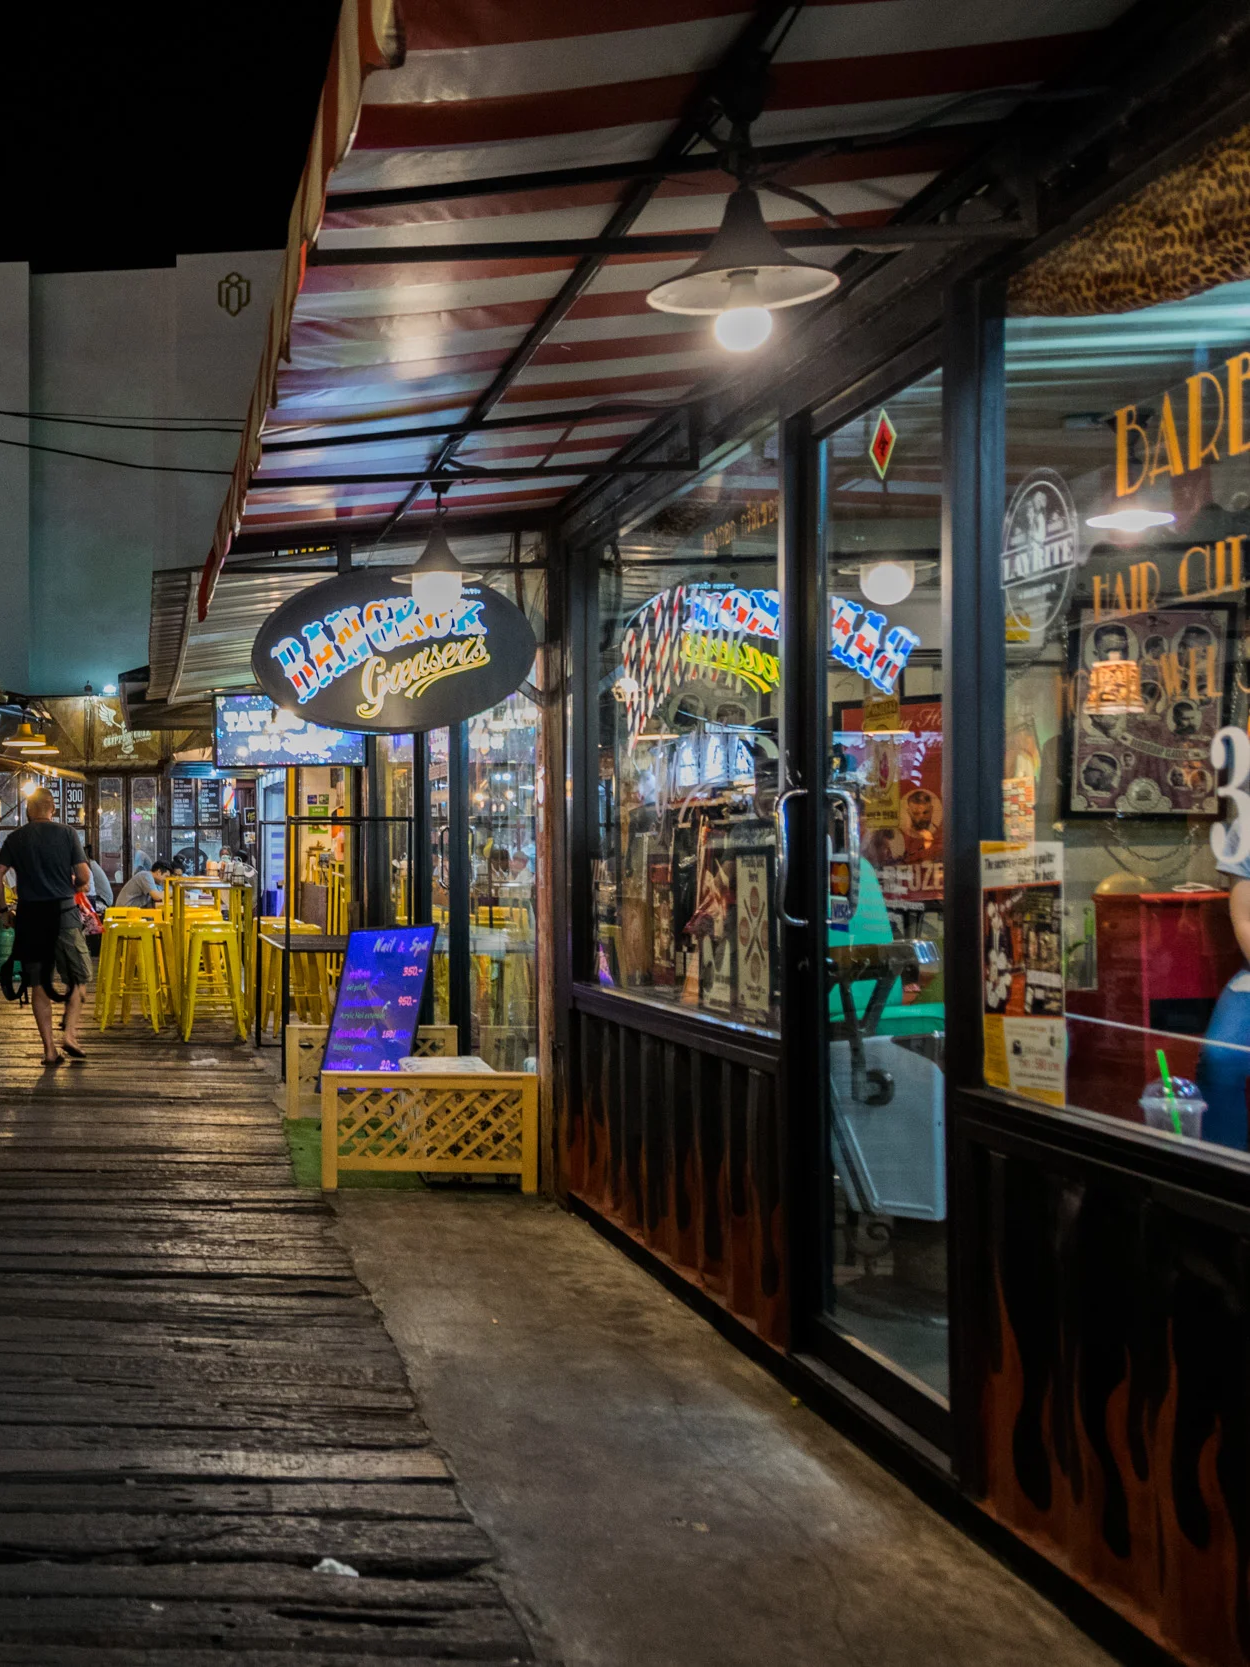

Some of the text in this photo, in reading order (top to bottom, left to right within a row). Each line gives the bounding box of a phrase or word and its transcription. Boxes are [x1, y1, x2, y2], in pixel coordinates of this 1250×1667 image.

[1093, 534, 1247, 622] HAIR CUT
[271, 597, 487, 704] BANGKOK
[356, 635, 491, 720] Greasers
[67, 789, 83, 803] 300
[373, 936, 397, 953] Nail
[409, 936, 430, 958] Spa
